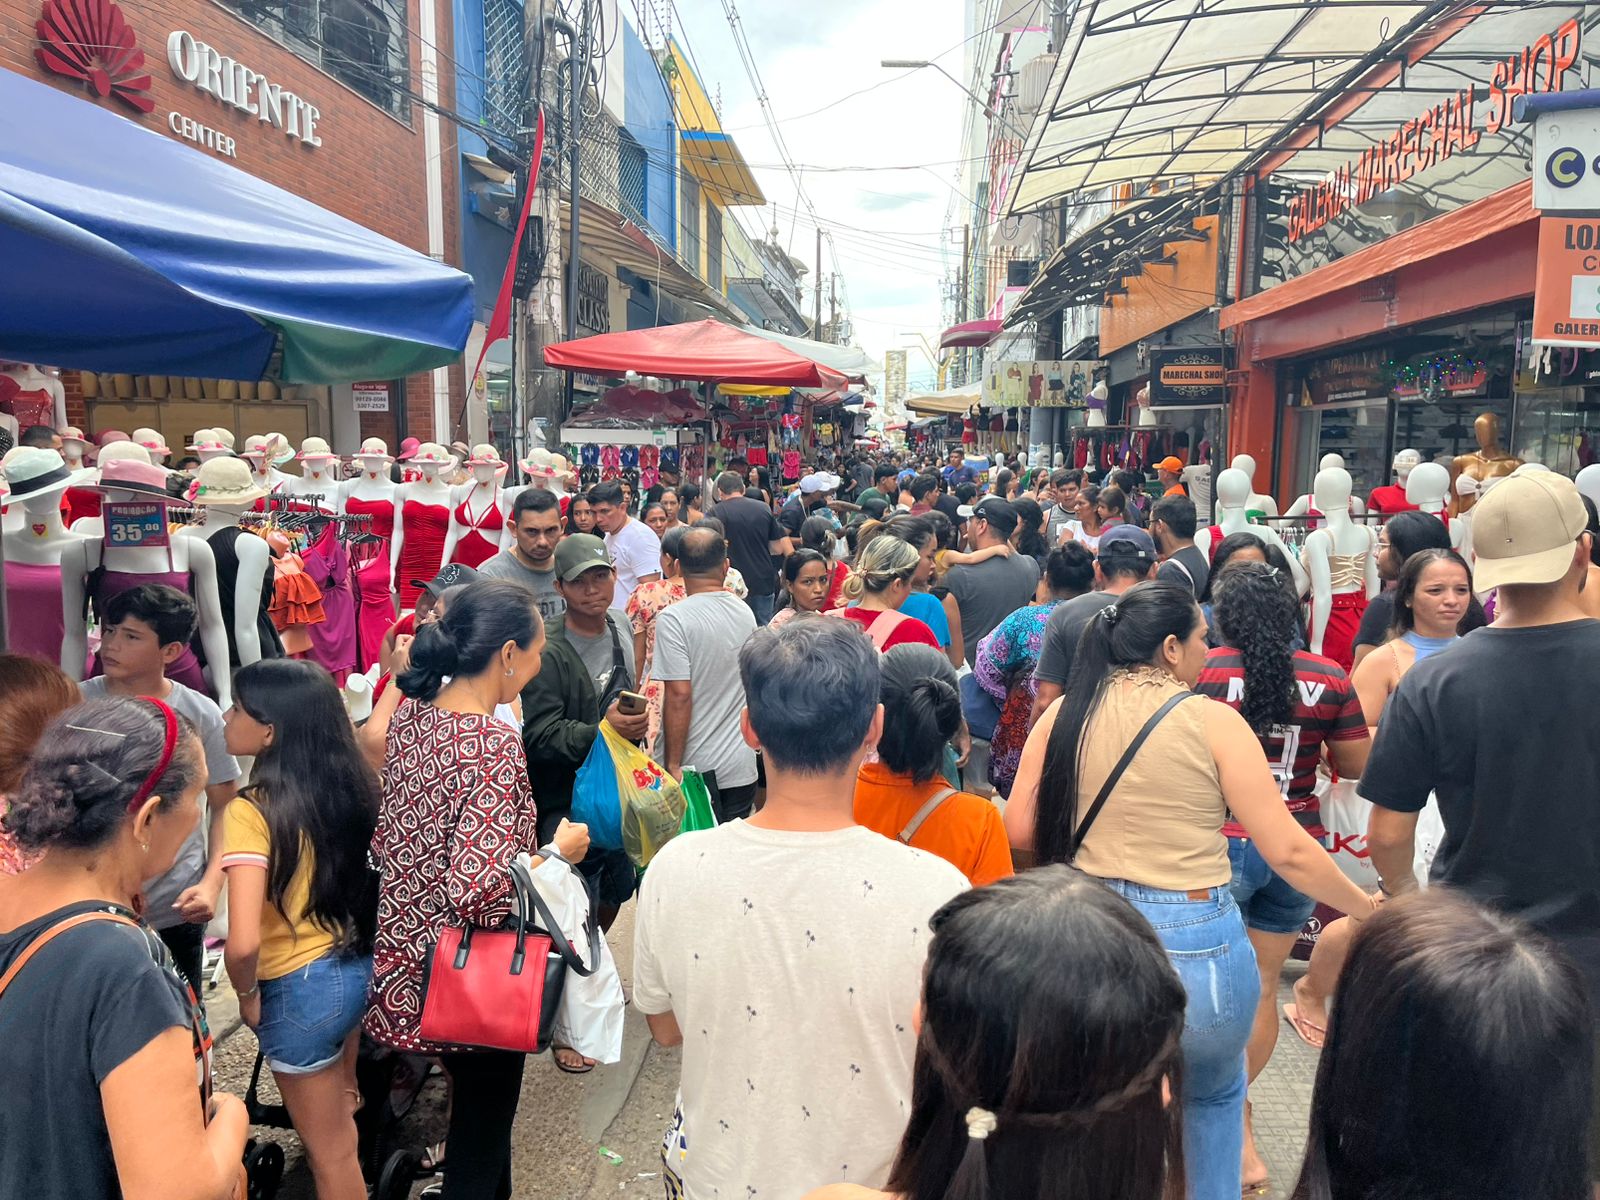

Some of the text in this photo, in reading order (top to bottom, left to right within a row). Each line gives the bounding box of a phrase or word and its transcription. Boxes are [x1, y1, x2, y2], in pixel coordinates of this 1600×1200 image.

[167, 30, 322, 147] ORIENTE
[168, 111, 237, 158] CENTER
[1288, 18, 1582, 242] GALERIA MARECHAL SHOP
[1163, 371, 1203, 379] MARECHAL
